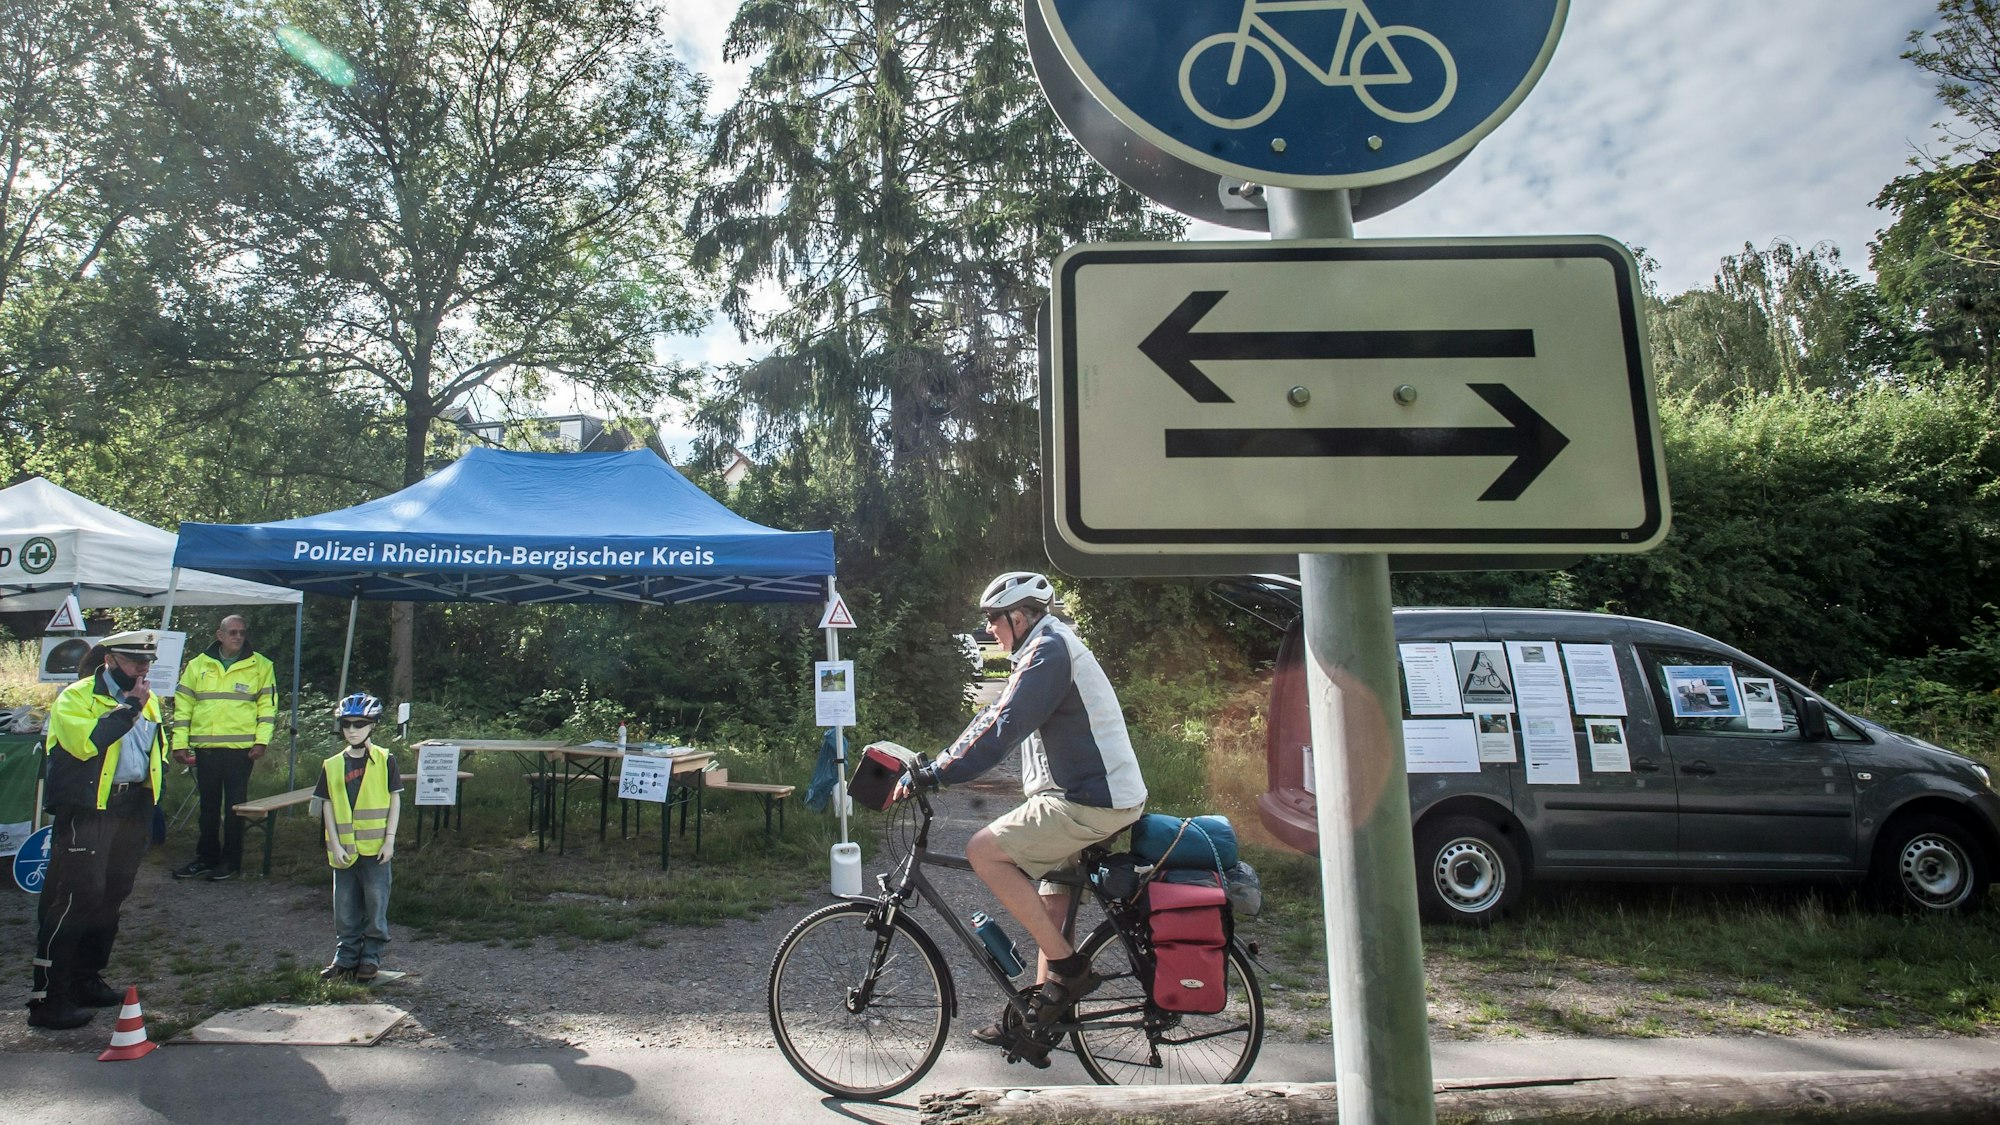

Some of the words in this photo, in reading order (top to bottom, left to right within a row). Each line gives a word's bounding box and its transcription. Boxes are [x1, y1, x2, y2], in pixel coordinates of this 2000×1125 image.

[293, 541, 375, 562] Polizei
[382, 543, 645, 571] Rheinisch-Bergischer
[652, 546, 715, 566] Kreis
